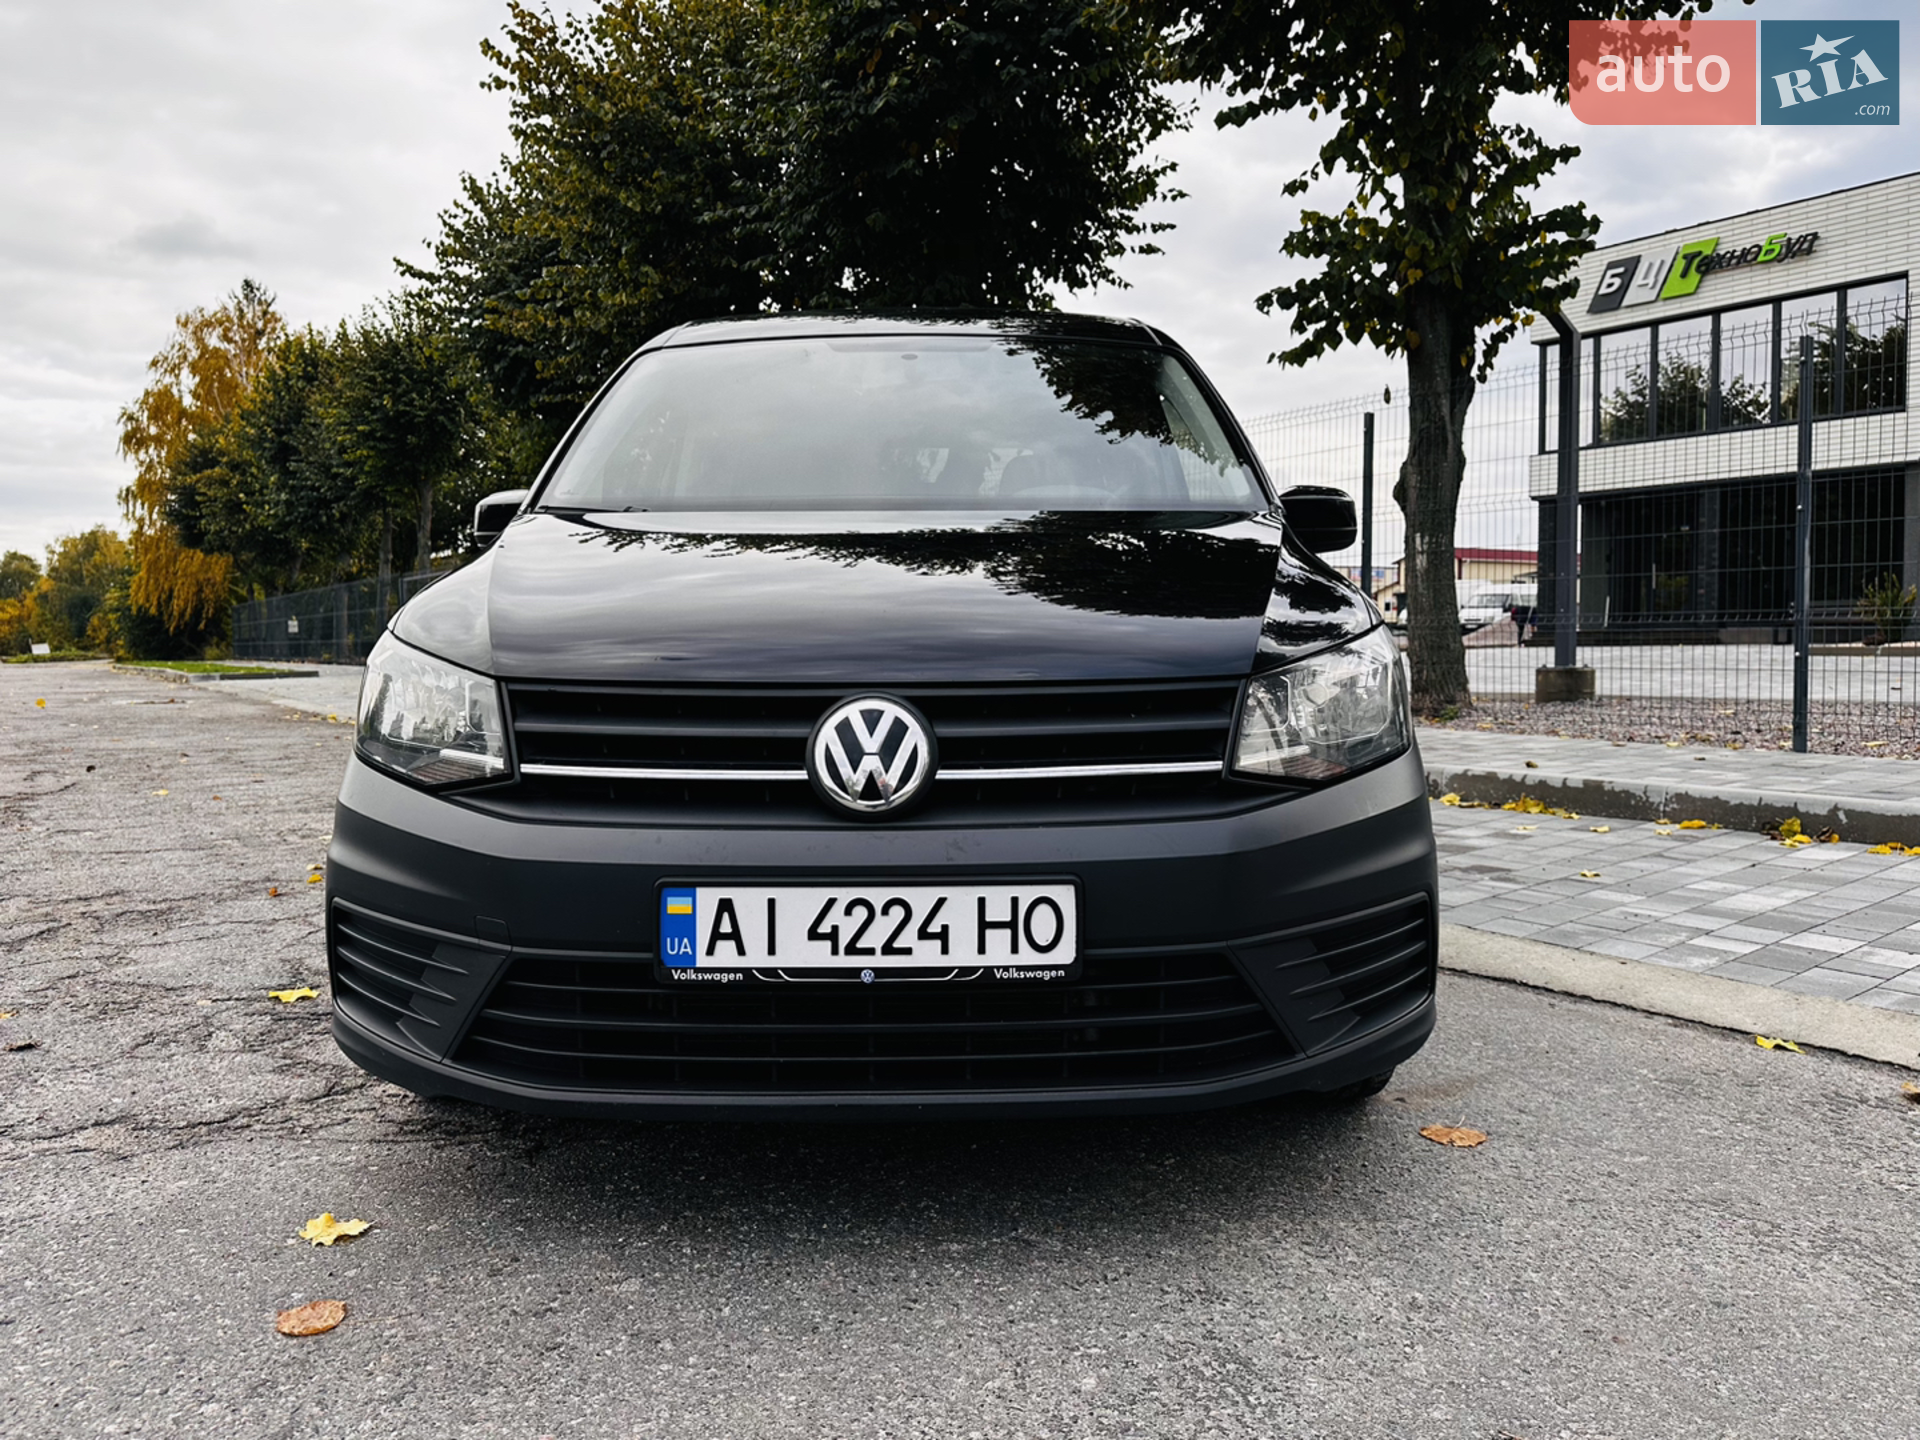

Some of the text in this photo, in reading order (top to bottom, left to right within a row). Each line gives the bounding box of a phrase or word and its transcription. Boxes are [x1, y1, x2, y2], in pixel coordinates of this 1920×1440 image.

[705, 895, 1065, 957] AI 4224 HO
[666, 937, 693, 956] UA
[671, 968, 744, 983] Volkswagen
[993, 967, 1065, 981] Volkswagen
